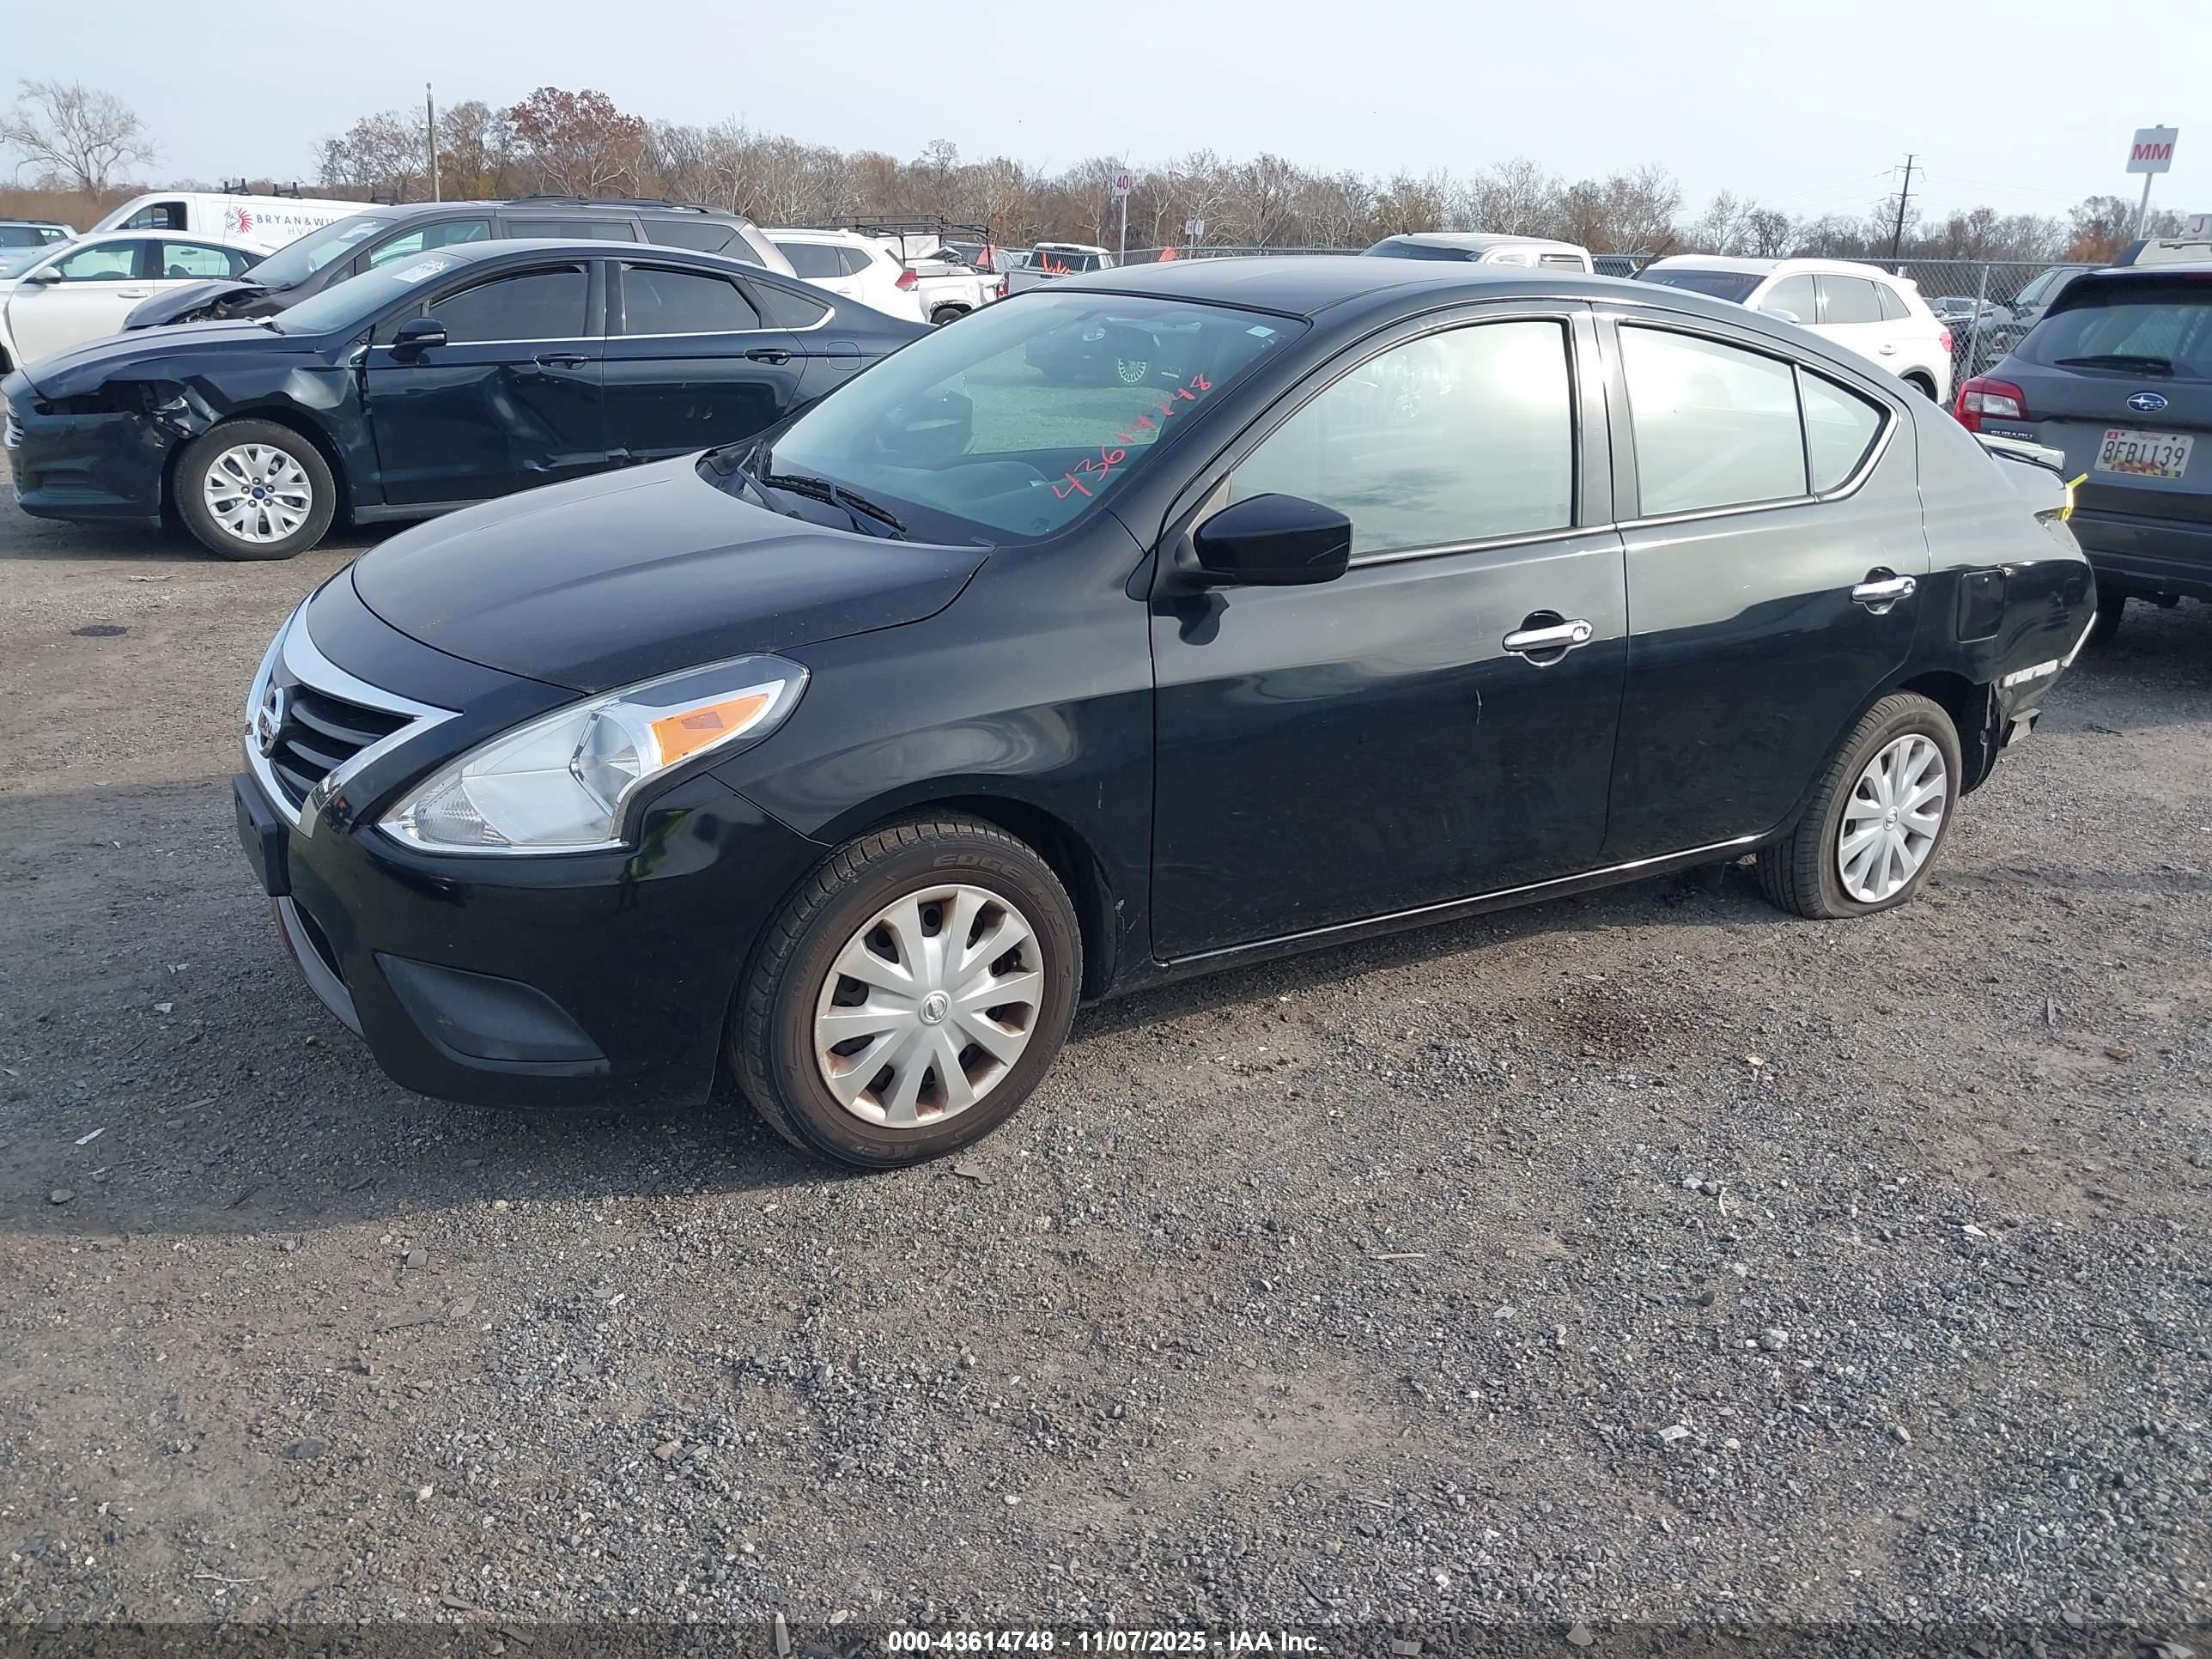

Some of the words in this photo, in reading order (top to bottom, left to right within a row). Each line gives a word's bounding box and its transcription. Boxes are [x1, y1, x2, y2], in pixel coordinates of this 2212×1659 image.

[2131, 143, 2172, 161] MM
[1116, 174, 1129, 190] 40
[2191, 216, 2205, 234] J
[2102, 441, 2185, 468] 8FB1139
